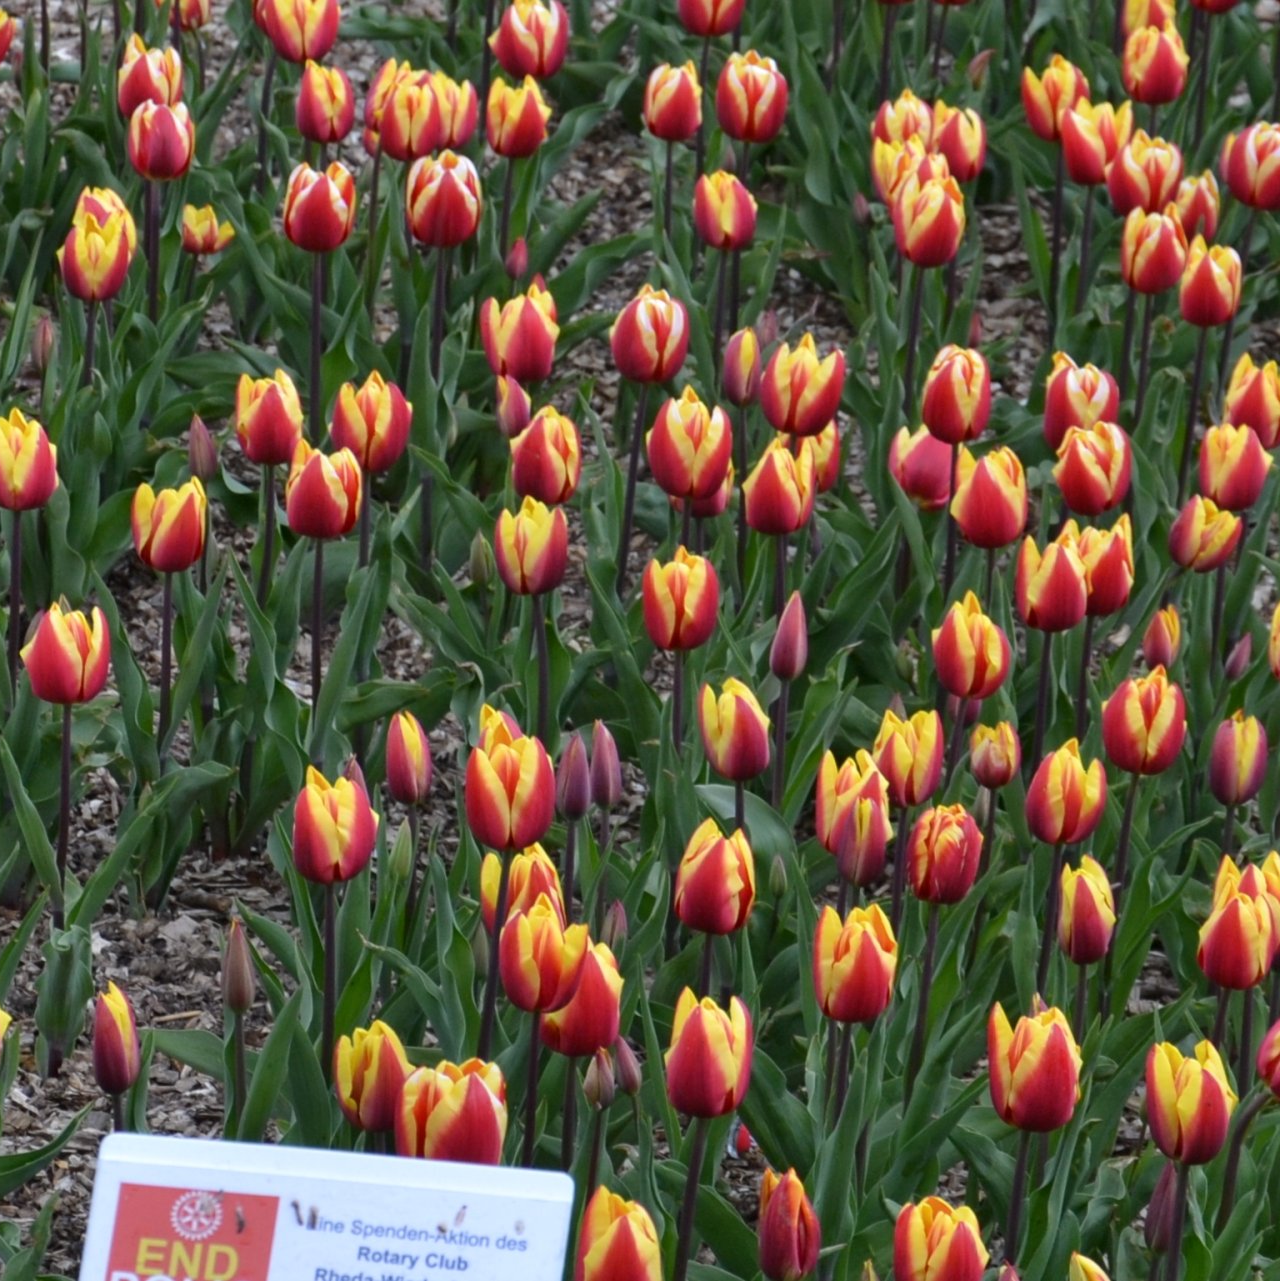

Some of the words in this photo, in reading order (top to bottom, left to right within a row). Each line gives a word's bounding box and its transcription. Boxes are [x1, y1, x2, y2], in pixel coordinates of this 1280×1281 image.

[350, 1219, 490, 1248] Spenden-Aktion
[496, 1234, 528, 1252] des
[135, 1237, 239, 1281] END
[357, 1245, 419, 1270] Rotary
[425, 1252, 469, 1272] Club
